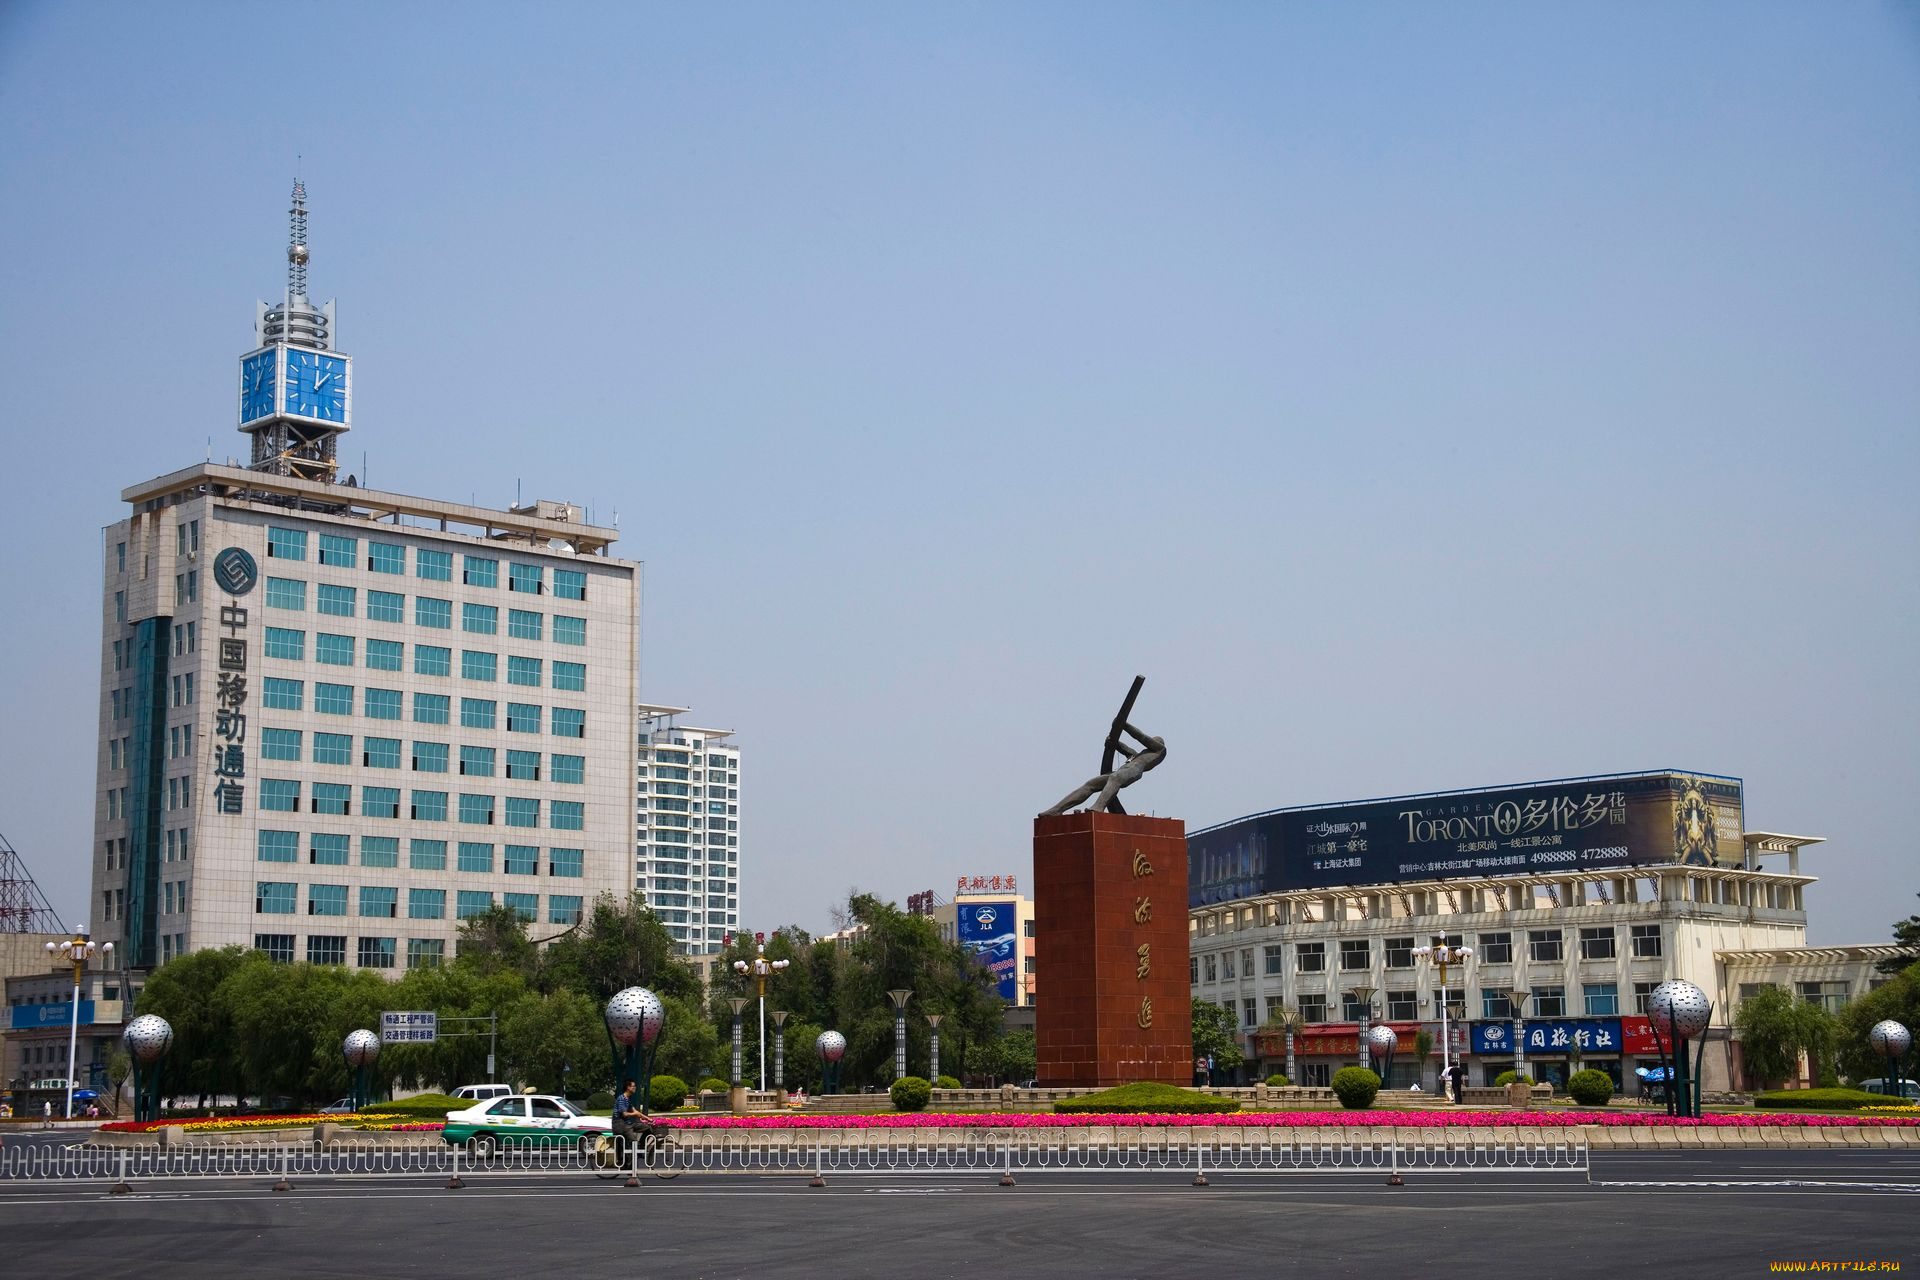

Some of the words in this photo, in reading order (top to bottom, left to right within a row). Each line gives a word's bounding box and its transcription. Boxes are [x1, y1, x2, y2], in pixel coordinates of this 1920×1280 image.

[213, 600, 249, 815] 中国移动通信
[1426, 803, 1494, 816] GARDEN
[1522, 793, 1608, 833] 多伦多
[1608, 791, 1626, 825] 花园
[1398, 801, 1521, 843] TORONTO
[1456, 840, 1498, 853] 北美风尚
[1500, 835, 1562, 849] 一线江景公寓
[1323, 857, 1362, 869] 上海证大集团
[1530, 850, 1577, 864] 4988888
[1580, 845, 1629, 860] 4728888
[957, 875, 1016, 890] 民航售票
[980, 923, 993, 931] JLA
[384, 1030, 434, 1040] 交通管理样板路
[1520, 1027, 1612, 1048] 国旅行社
[1483, 1041, 1507, 1049] 吉林市
